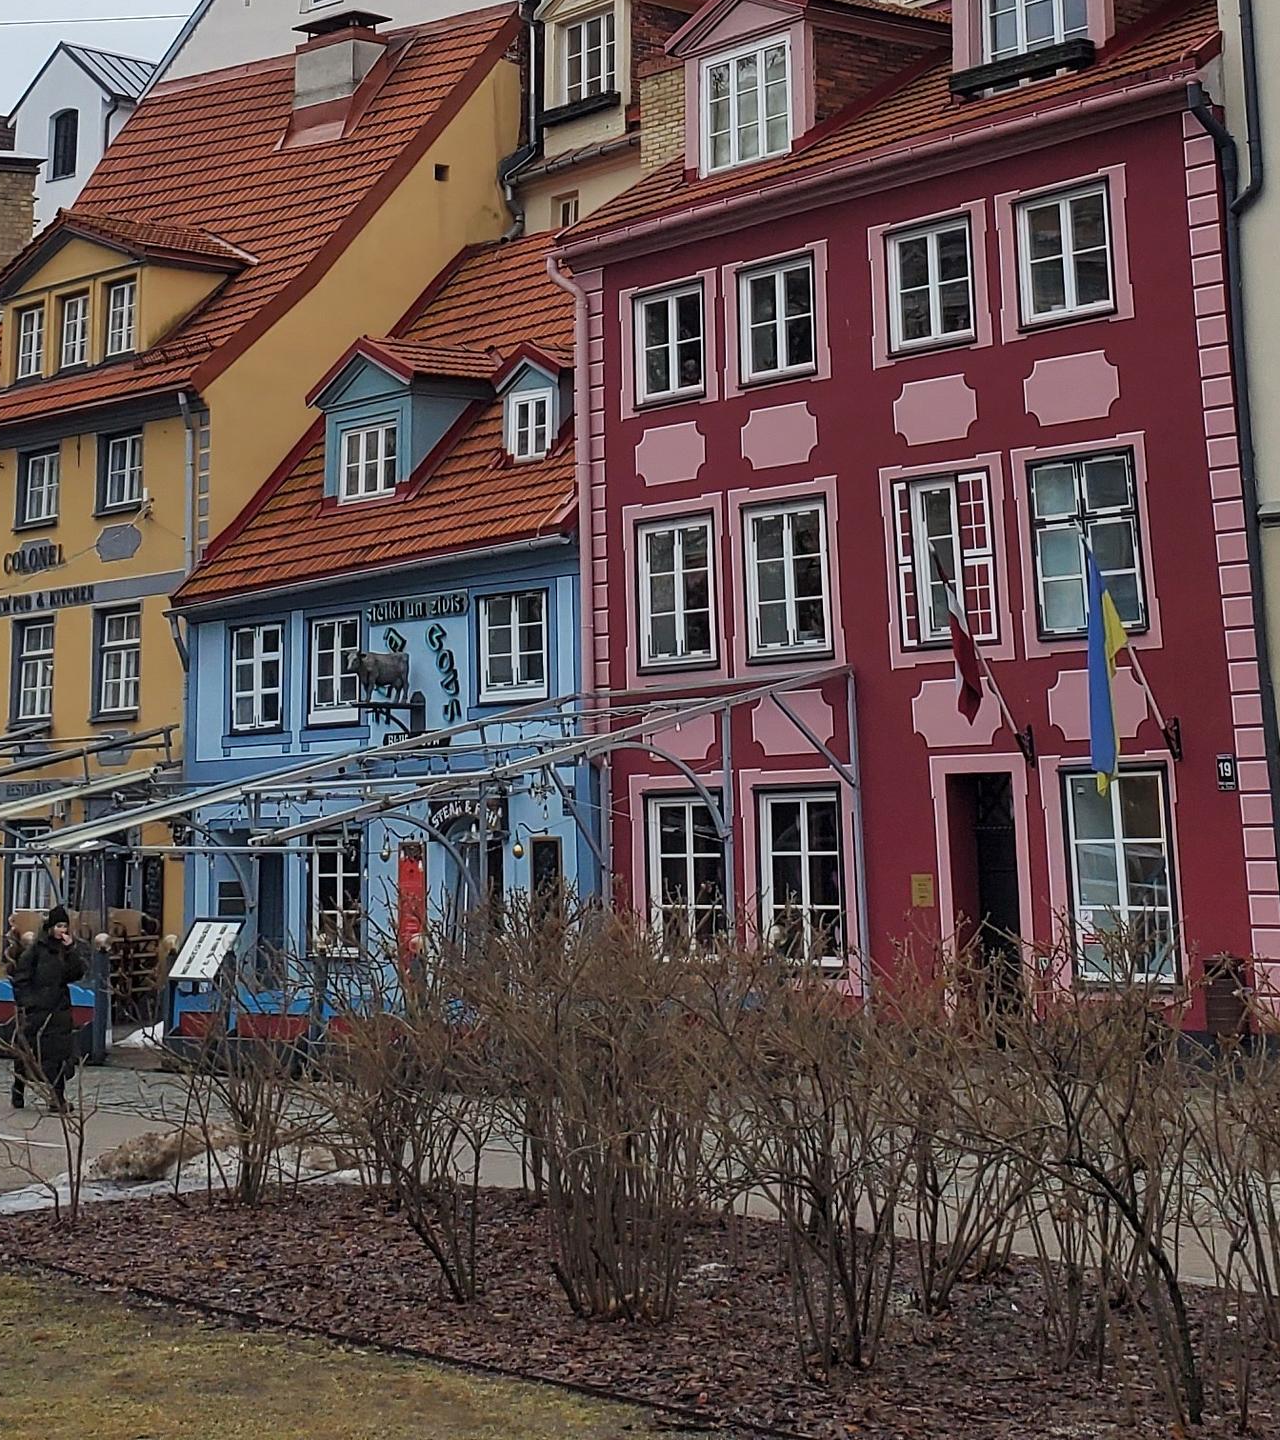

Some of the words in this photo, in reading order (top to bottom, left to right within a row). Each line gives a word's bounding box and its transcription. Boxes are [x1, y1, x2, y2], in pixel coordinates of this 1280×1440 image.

[3, 544, 66, 575] COLONEL
[36, 592, 45, 608] &
[49, 585, 94, 607] KITCHEN
[407, 599, 424, 617] un
[1218, 761, 1232, 777] 19
[431, 801, 462, 828] STEAK
[465, 800, 473, 814] &
